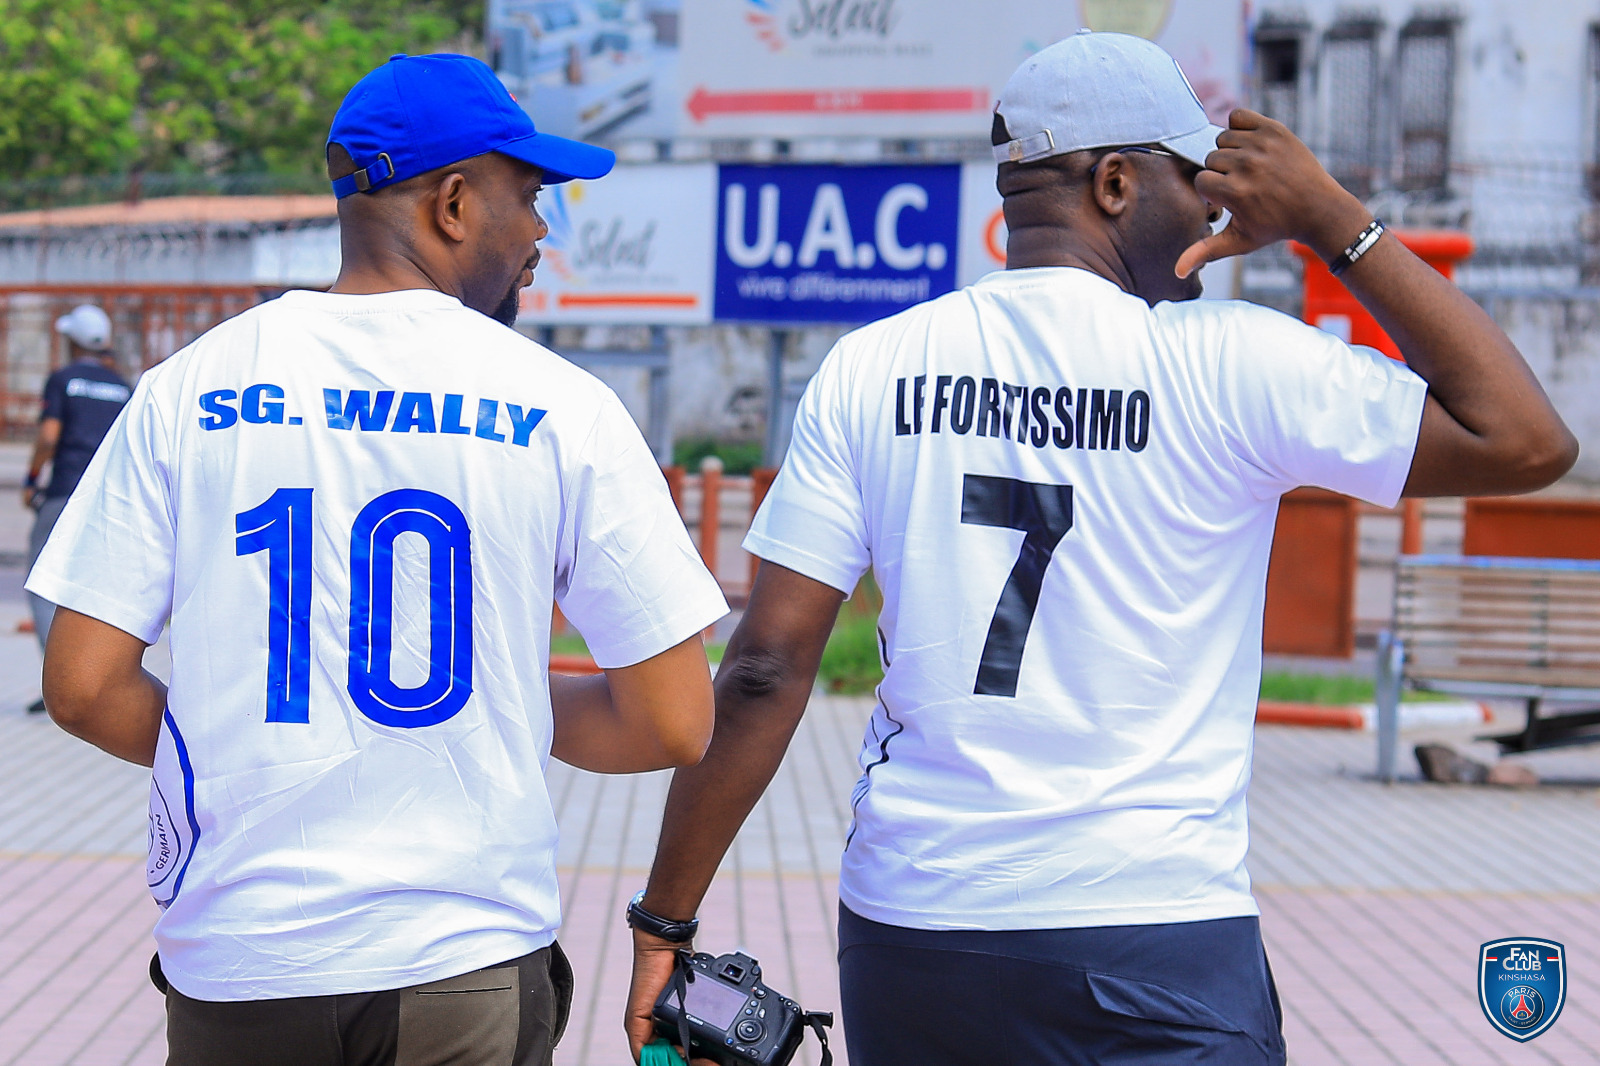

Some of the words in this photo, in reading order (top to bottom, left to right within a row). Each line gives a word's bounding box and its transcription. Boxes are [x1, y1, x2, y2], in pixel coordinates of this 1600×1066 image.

[724, 182, 947, 270] U.A.C.
[199, 383, 302, 431] SG.
[323, 388, 548, 447] WALLY
[931, 375, 1149, 452] FORTISSIMO
[235, 487, 474, 728] 10
[961, 473, 1073, 698] 7
[156, 814, 170, 870] GERMAIN
